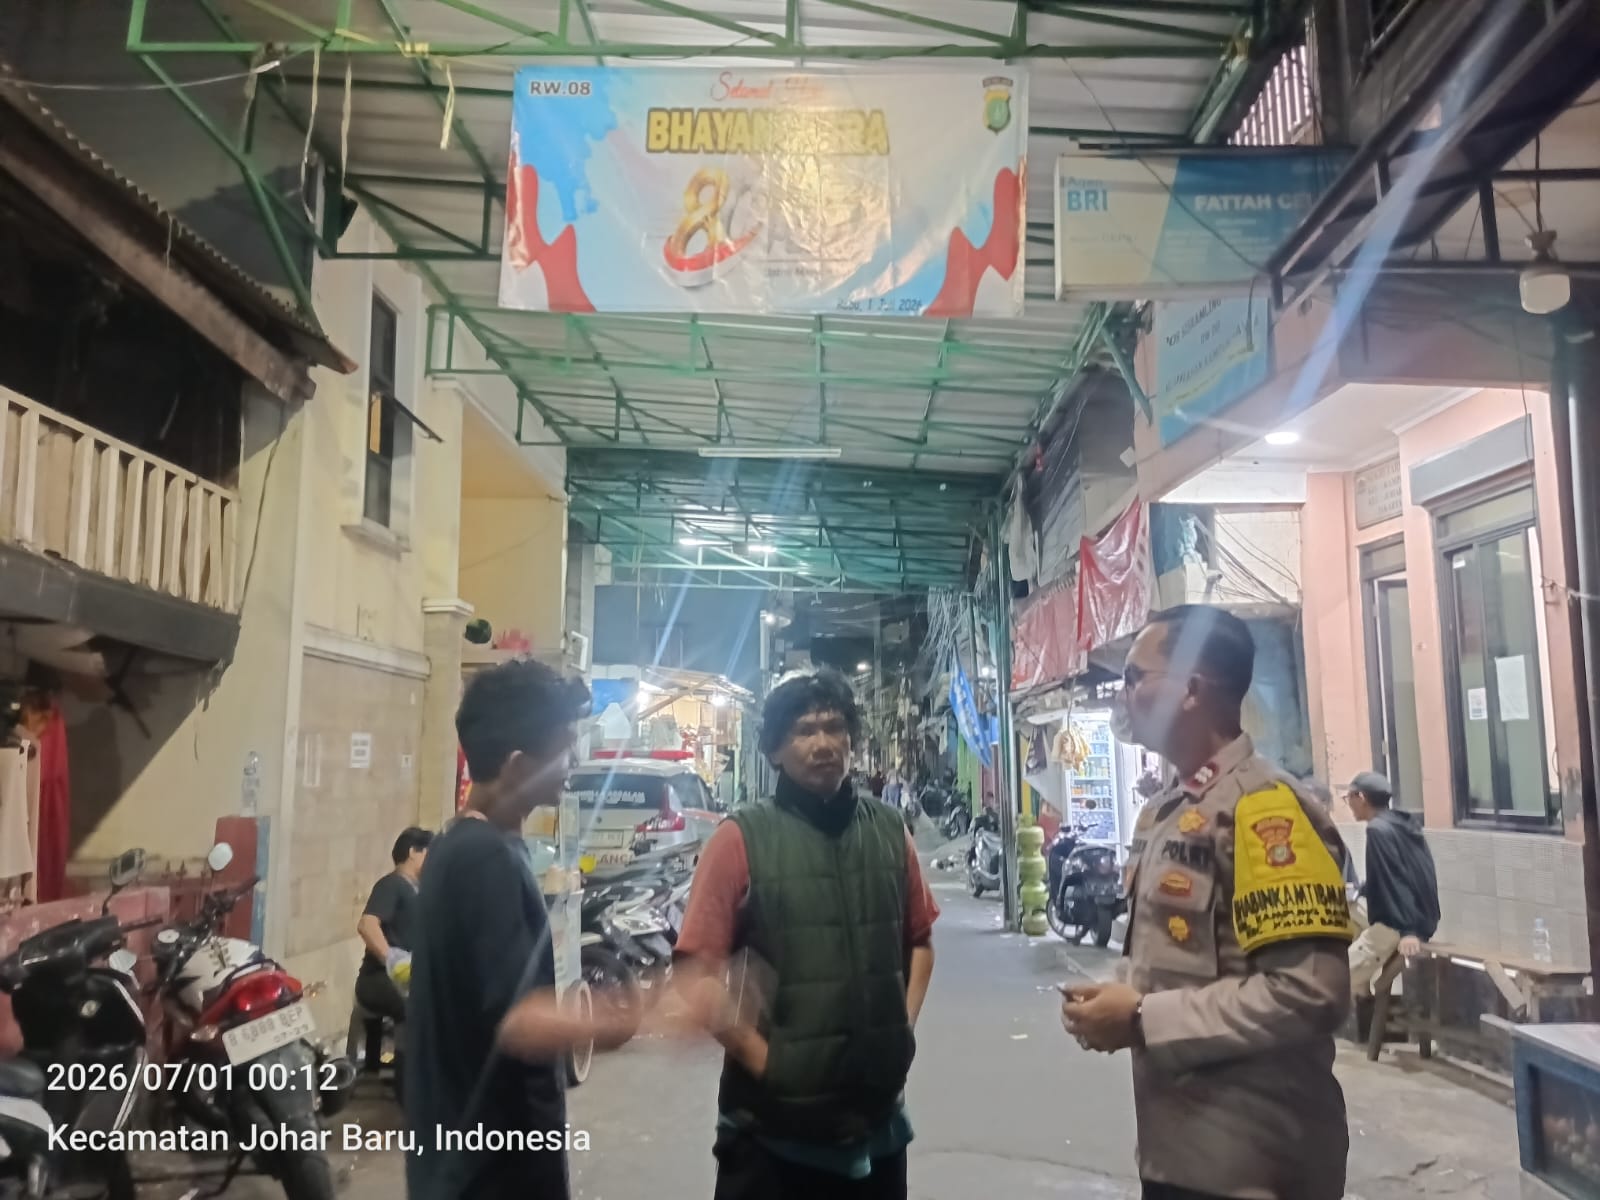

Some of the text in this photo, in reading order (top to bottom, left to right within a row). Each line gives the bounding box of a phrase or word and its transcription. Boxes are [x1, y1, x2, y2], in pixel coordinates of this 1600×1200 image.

[529, 80, 592, 97] RW.08
[646, 108, 890, 155] BHAYANRA
[1067, 189, 1108, 211] BRI
[1194, 194, 1271, 211] FATTAH
